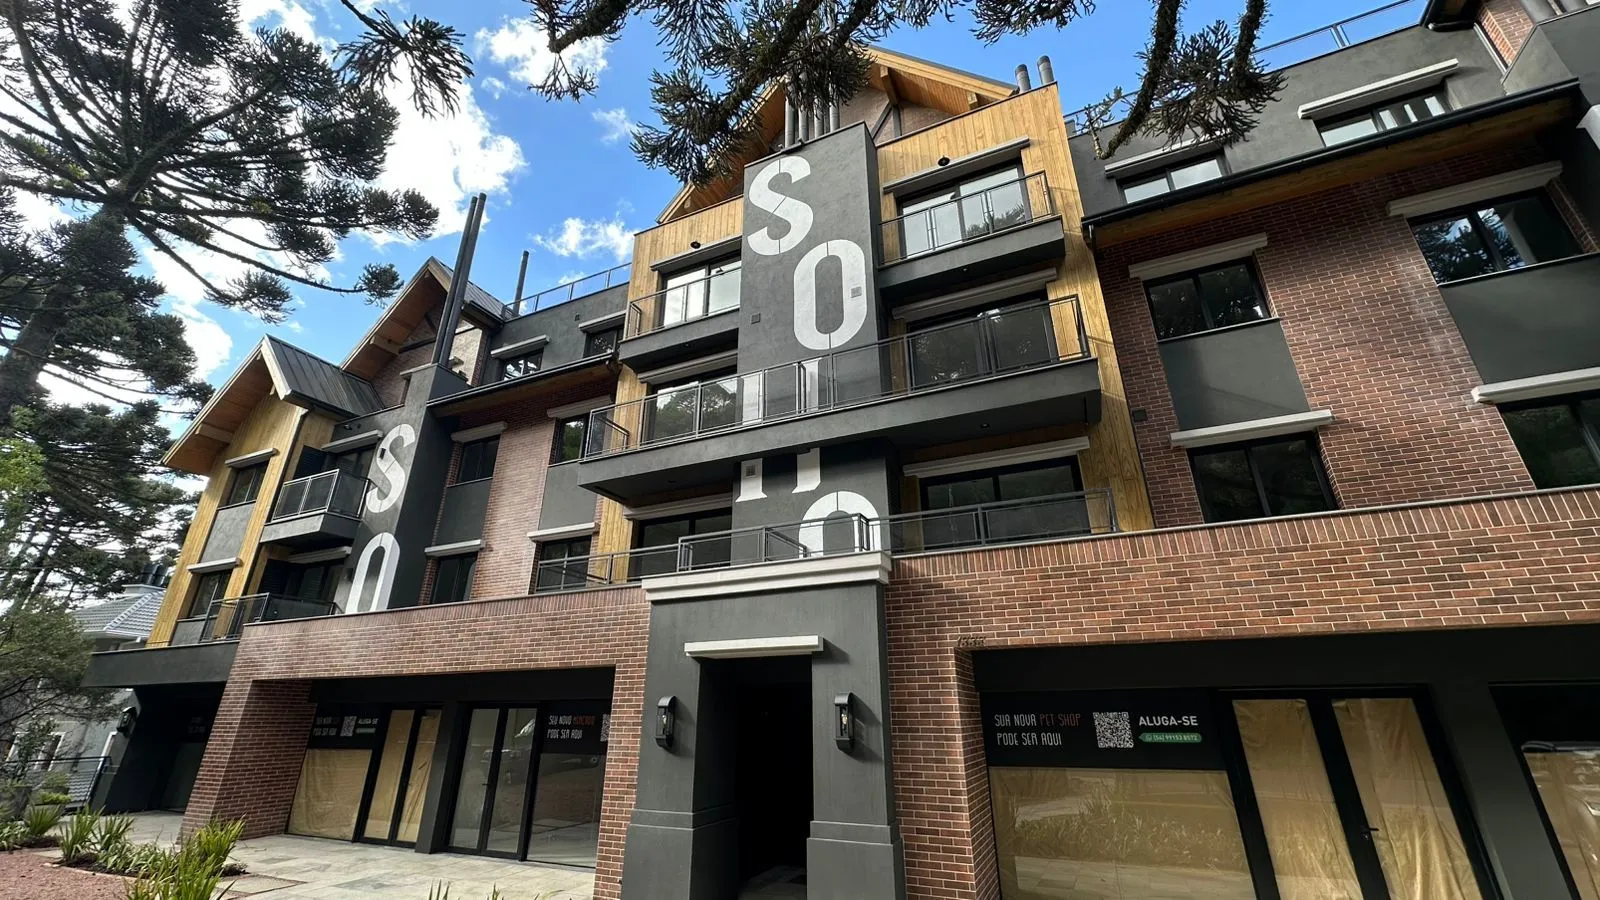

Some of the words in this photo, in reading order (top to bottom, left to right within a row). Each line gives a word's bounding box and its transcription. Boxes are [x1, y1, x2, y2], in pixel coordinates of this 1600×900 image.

[994, 713, 1011, 727] SUA
[1013, 713, 1037, 727] NOVA
[1039, 713, 1055, 727] PET
[1057, 713, 1081, 727] SHOP
[1138, 715, 1199, 726] ALUGA-SE
[996, 732, 1019, 746] PODE
[1021, 732, 1038, 746] SER
[1041, 732, 1062, 746] AQUI
